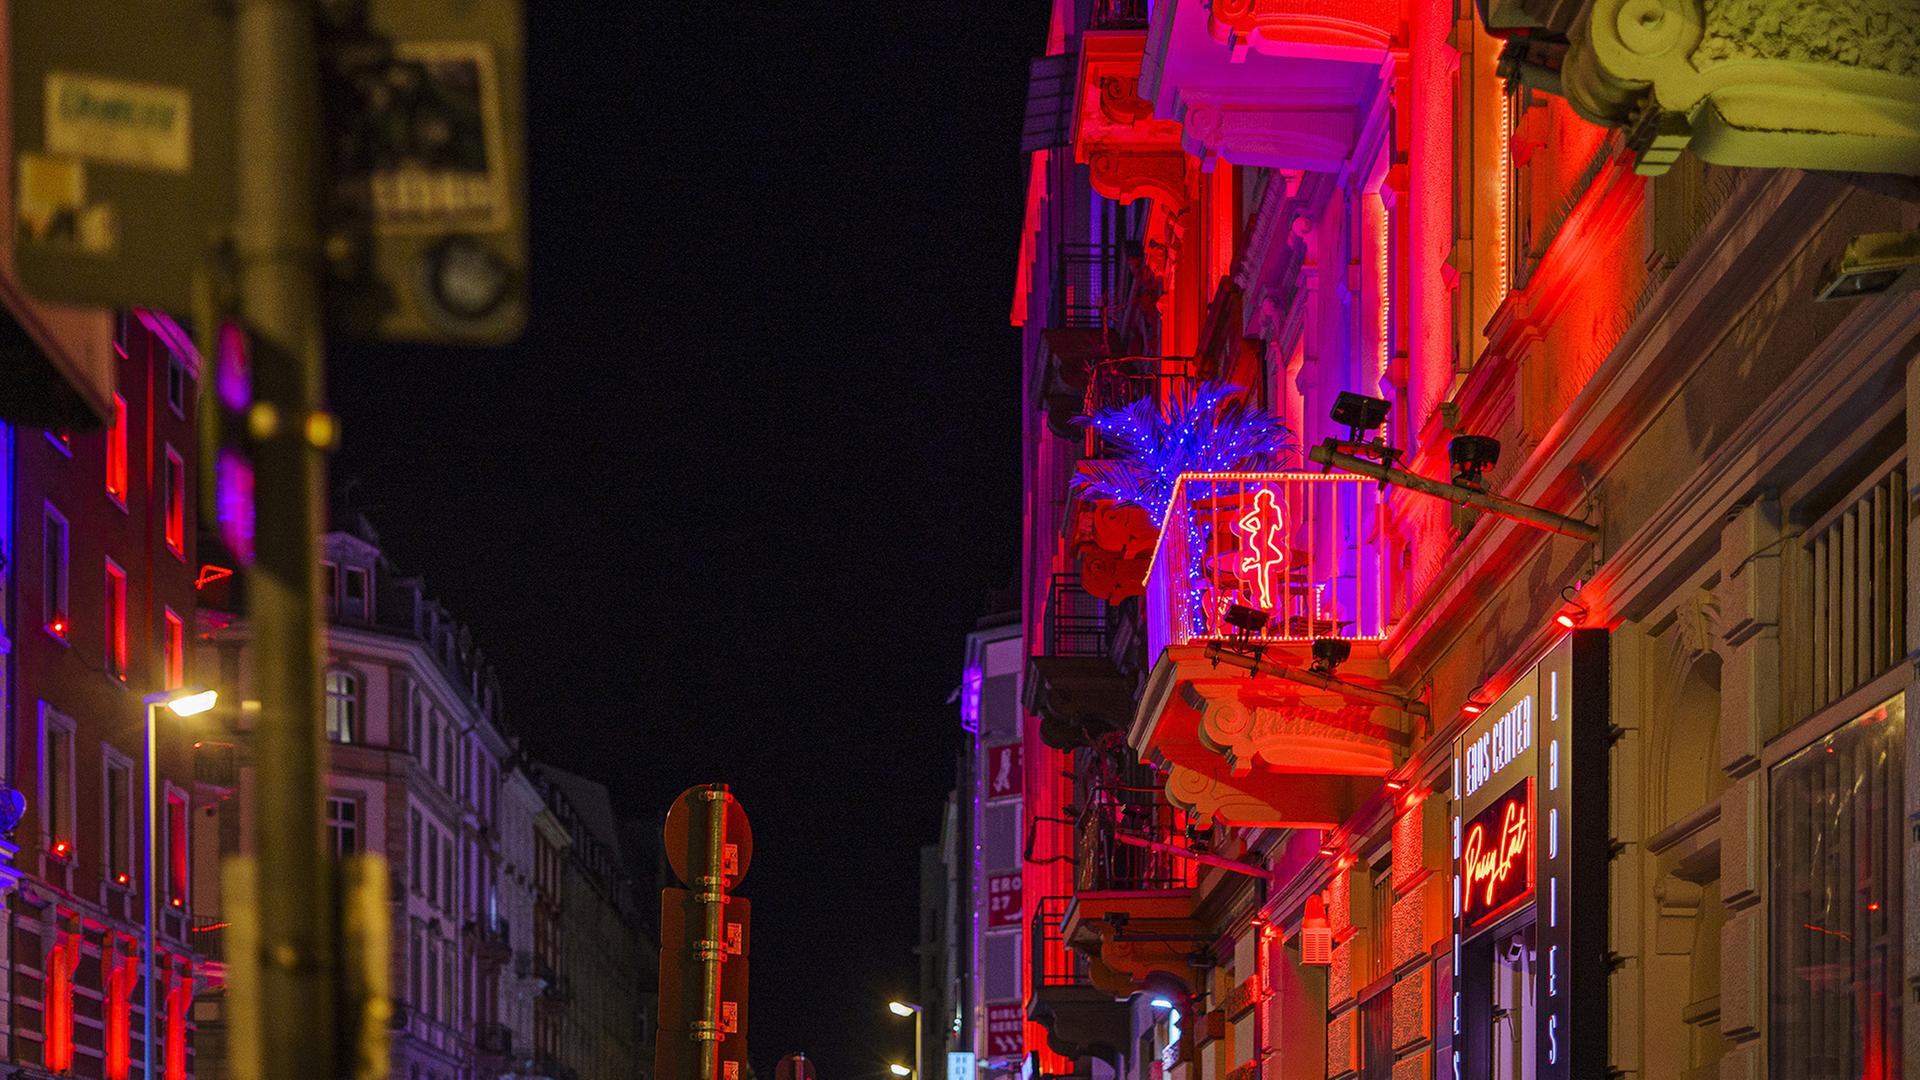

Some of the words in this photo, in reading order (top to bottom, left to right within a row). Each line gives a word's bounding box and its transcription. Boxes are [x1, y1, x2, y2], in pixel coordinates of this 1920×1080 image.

[1466, 731, 1491, 797] EROS
[1492, 695, 1532, 774] CENTER
[1500, 802, 1527, 881] Cat
[1549, 671, 1559, 1065] LADIES
